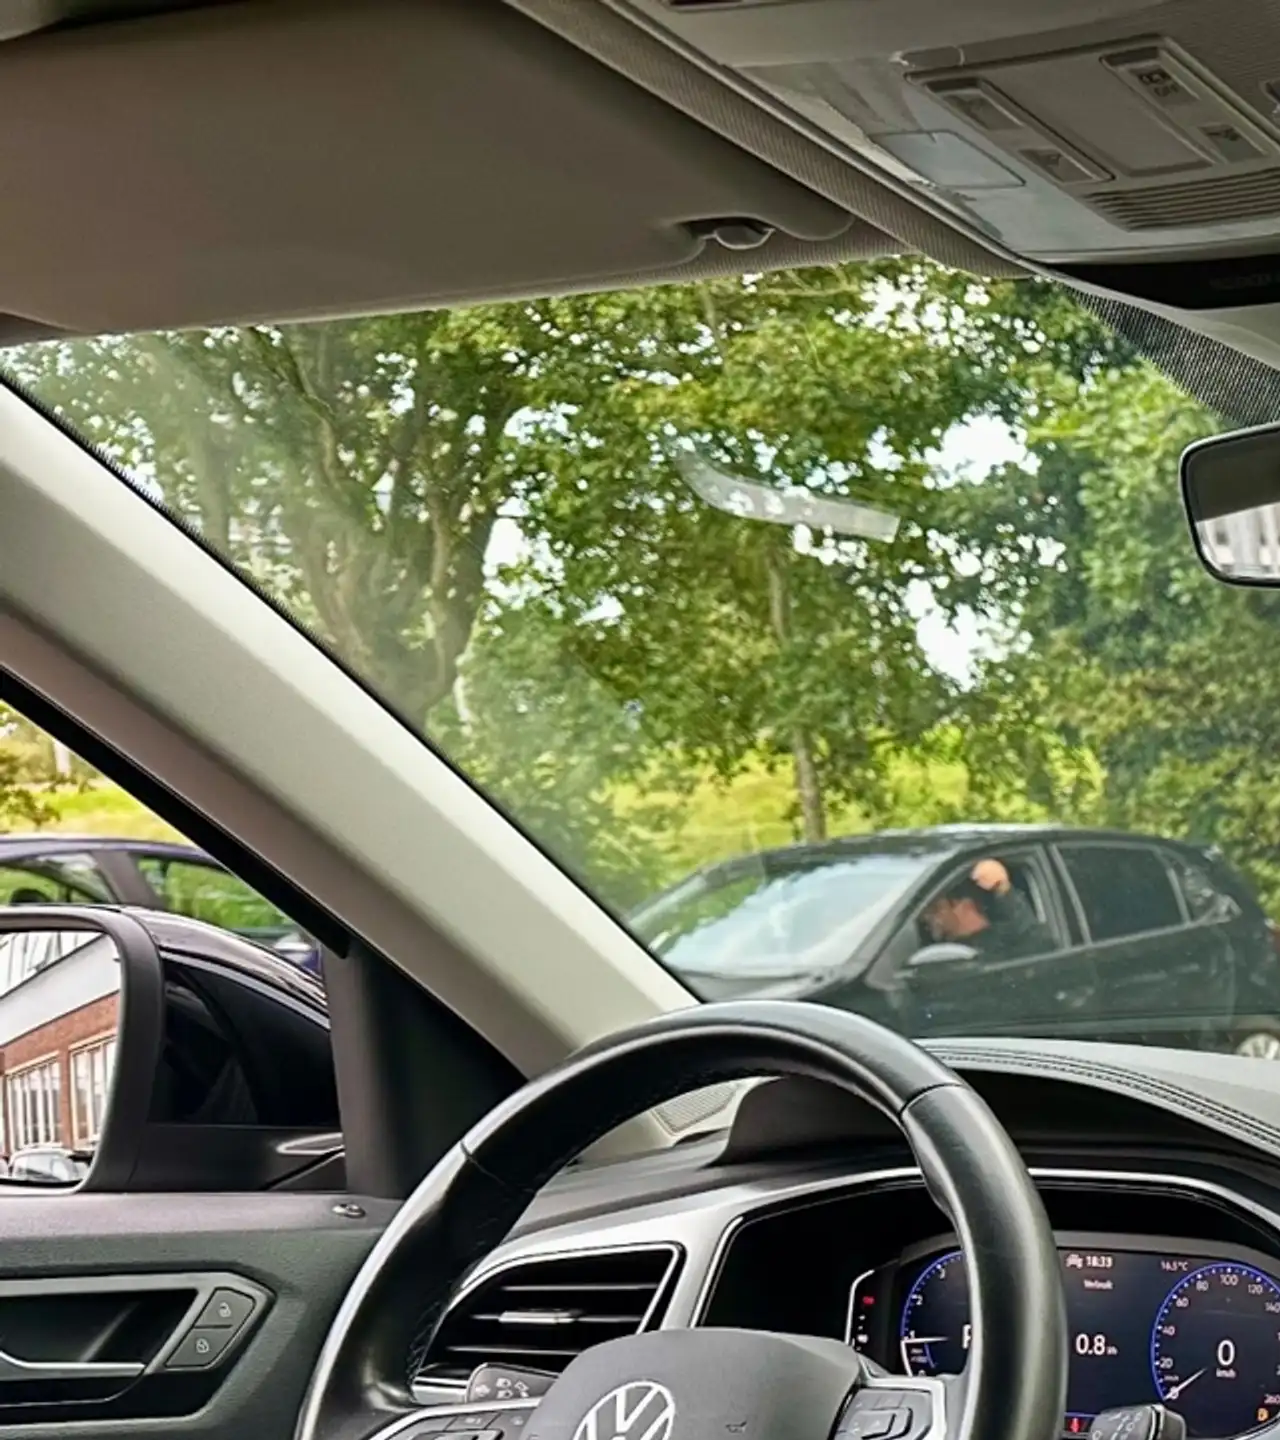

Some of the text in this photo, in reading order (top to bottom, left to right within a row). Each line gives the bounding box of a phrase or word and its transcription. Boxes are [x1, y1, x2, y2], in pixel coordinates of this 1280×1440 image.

[1085, 1255, 1113, 1269] 18:33
[1195, 1280, 1210, 1292] 80
[1219, 1274, 1239, 1286] 100
[1247, 1284, 1264, 1295] 120
[1175, 1297, 1190, 1308] 60
[1162, 1324, 1176, 1336] 40
[1075, 1332, 1106, 1356] 0.8
[1217, 1339, 1235, 1366] 0
[1159, 1357, 1174, 1369] 20
